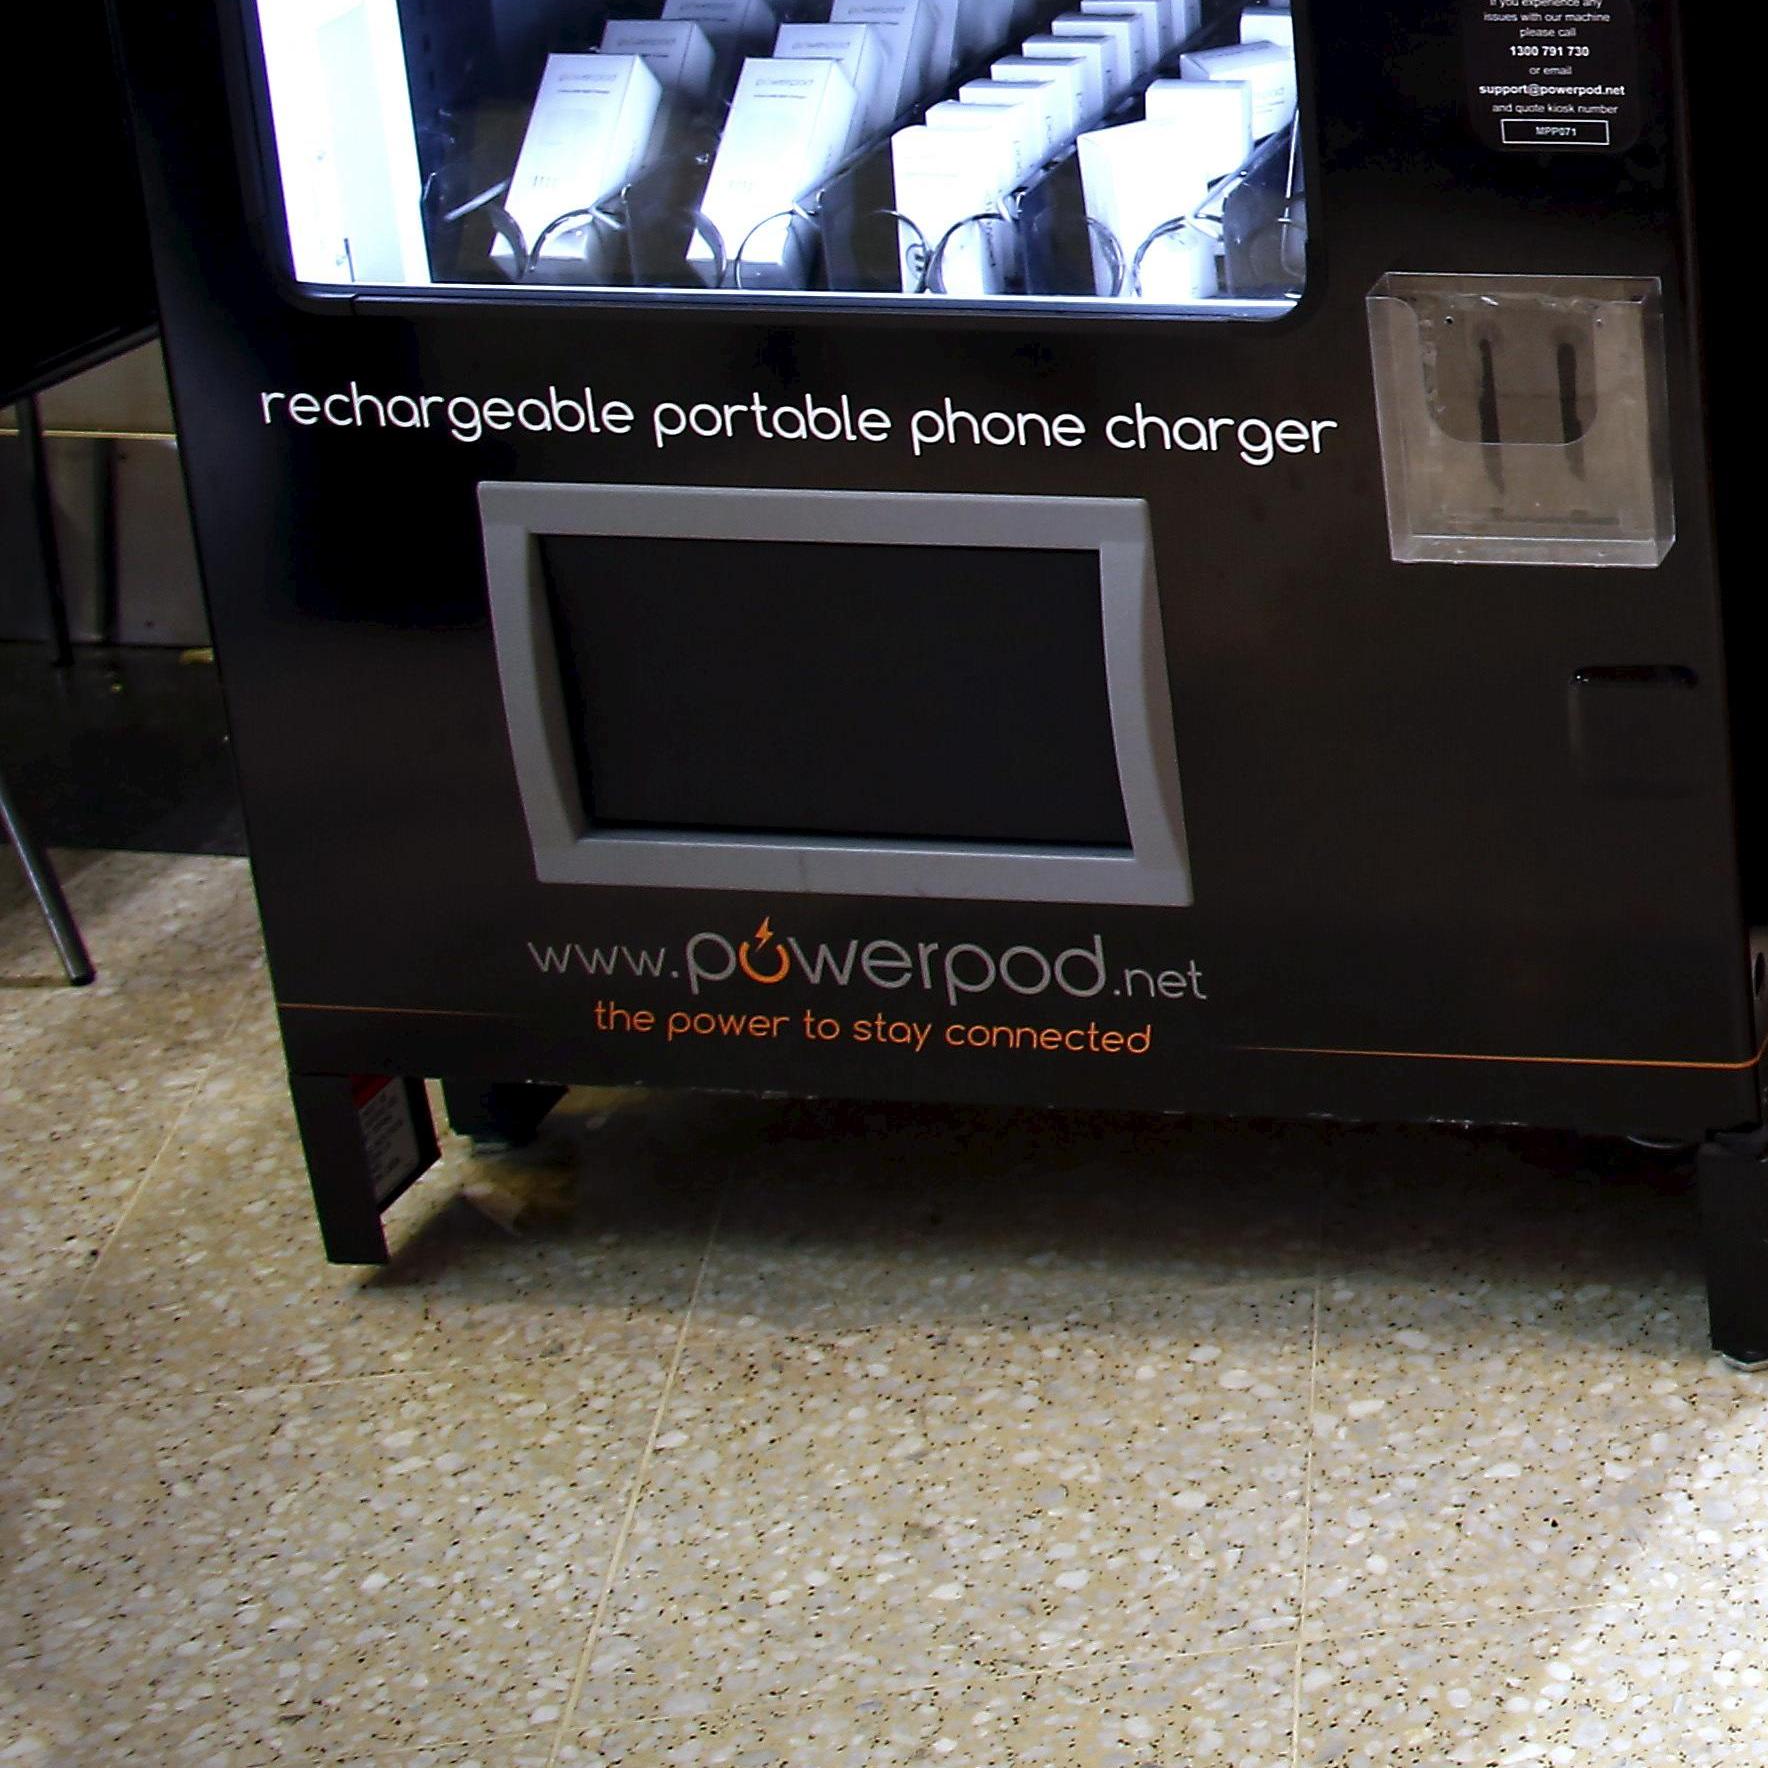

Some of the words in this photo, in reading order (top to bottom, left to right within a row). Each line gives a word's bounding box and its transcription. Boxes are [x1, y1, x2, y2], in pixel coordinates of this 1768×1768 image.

[1483, 13, 1518, 22] issues
[1520, 12, 1542, 22] with
[1544, 14, 1562, 22] our
[1565, 13, 1611, 23] machine
[1520, 28, 1555, 38] please
[1557, 27, 1577, 37] call
[1542, 46, 1563, 56] 791
[1529, 66, 1541, 75] or
[1543, 65, 1573, 76] email
[1479, 84, 1626, 97] support@powerpod.net
[1492, 104, 1512, 113] and
[1515, 104, 1545, 115] quote
[1547, 104, 1575, 114] kiosk
[1577, 104, 1618, 115] number
[261, 381, 634, 443] rechargeable
[652, 392, 892, 448] portable
[910, 398, 1085, 457] phone
[1104, 403, 1338, 466] charger
[528, 922, 1207, 1005] www.powerpod.net
[594, 1002, 655, 1033] the
[667, 1009, 789, 1042] power
[803, 1009, 840, 1040] to
[852, 1015, 933, 1053] stay
[945, 1022, 1152, 1055] connected
